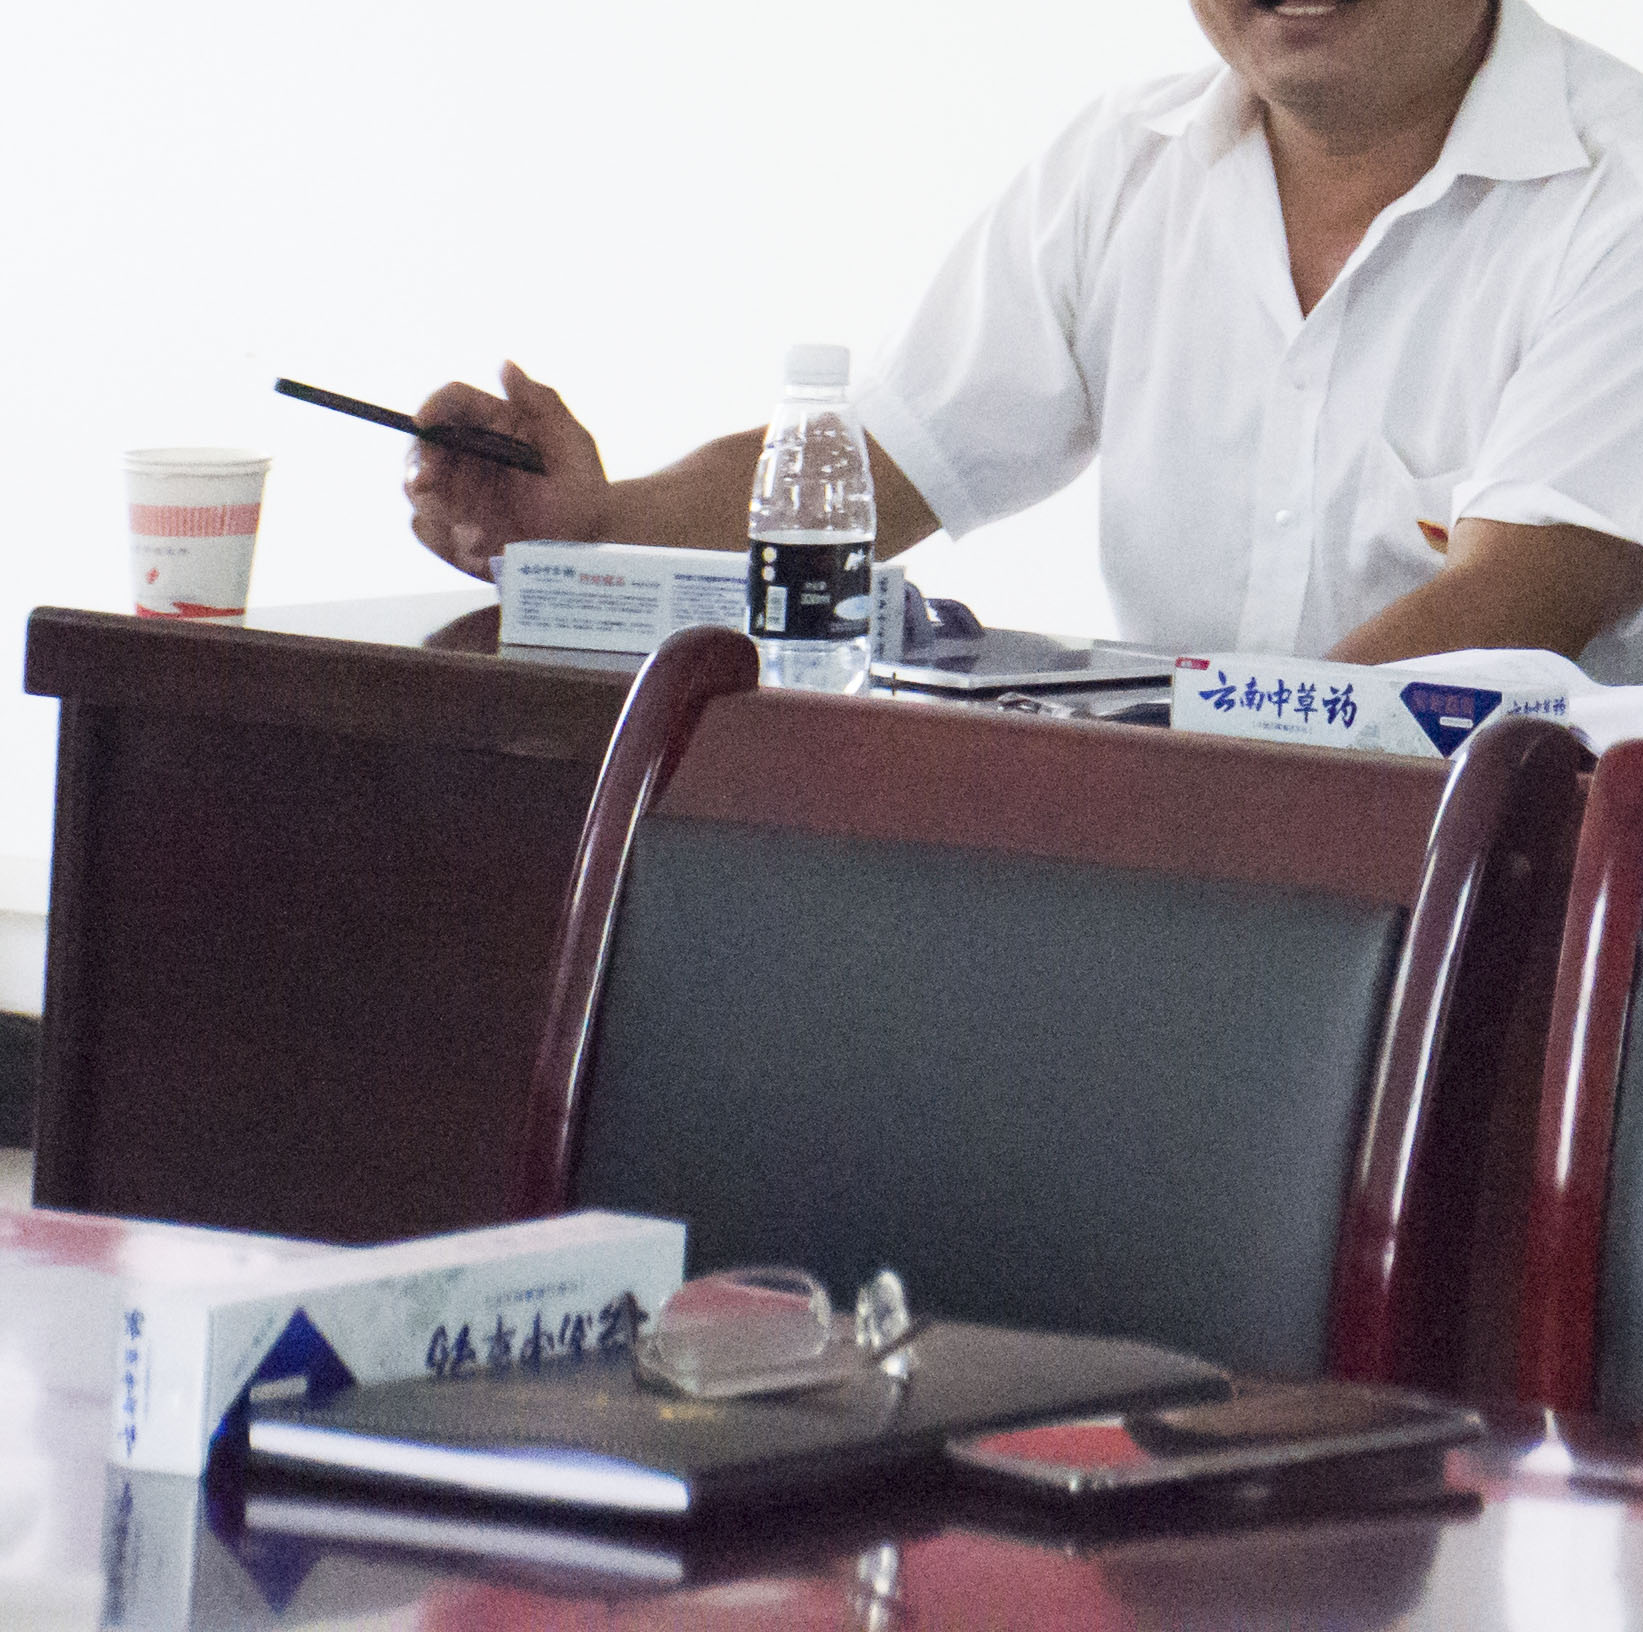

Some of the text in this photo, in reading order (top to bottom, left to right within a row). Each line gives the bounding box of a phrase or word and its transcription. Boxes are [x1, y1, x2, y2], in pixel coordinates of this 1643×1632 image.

[1198, 670, 1357, 729] 云南中草药
